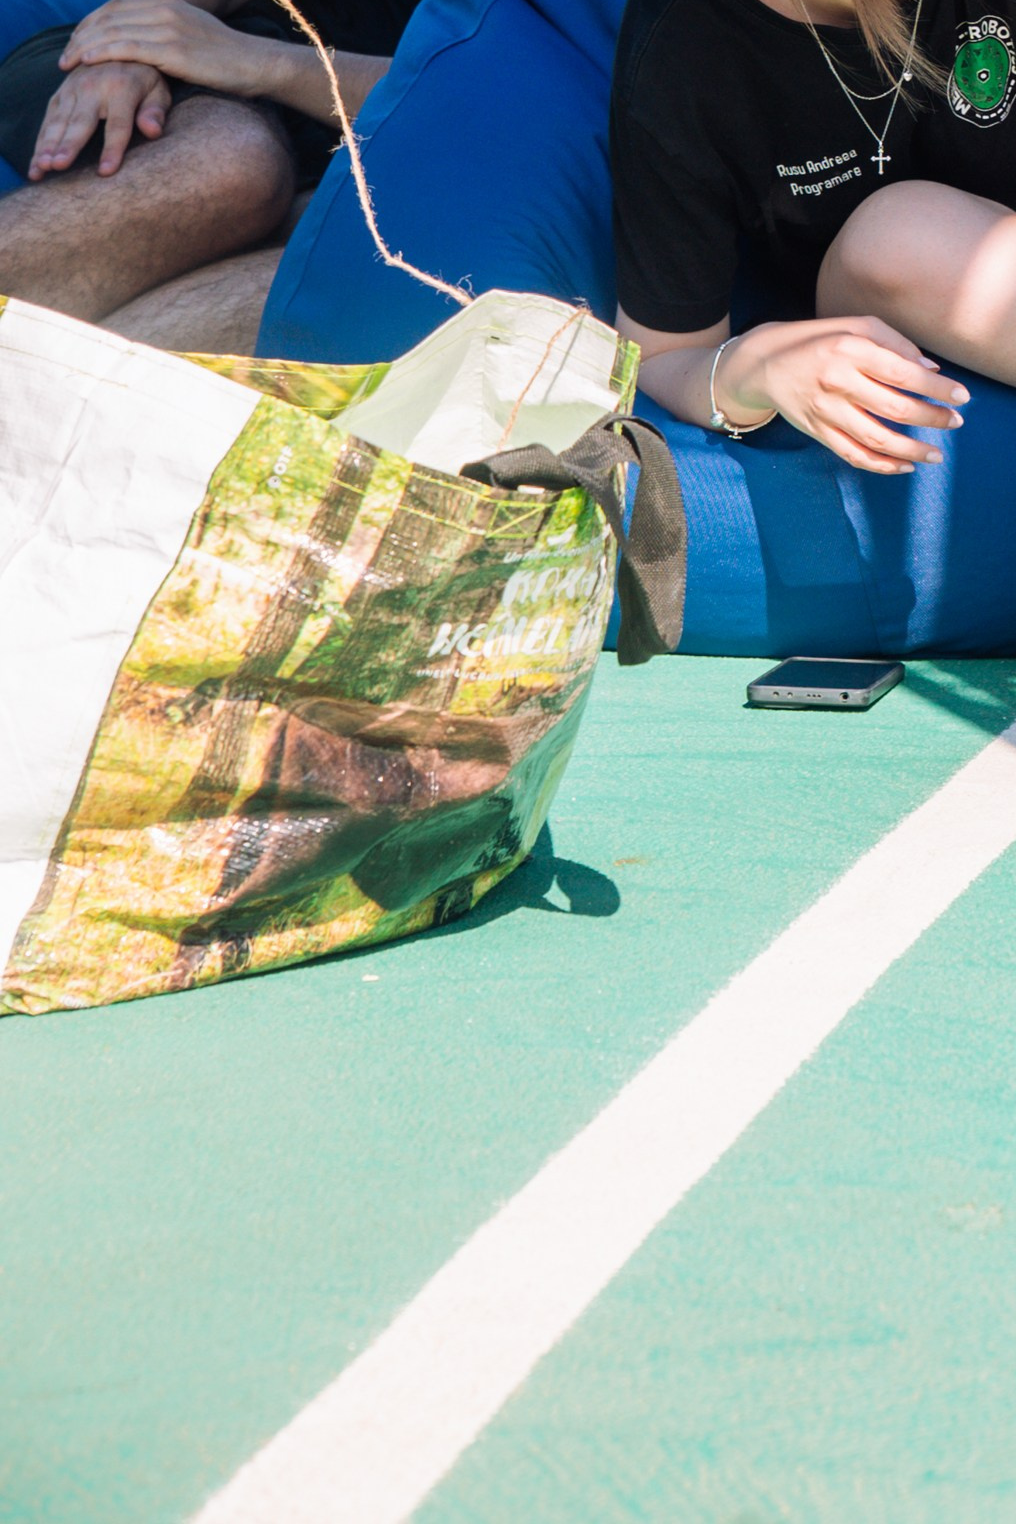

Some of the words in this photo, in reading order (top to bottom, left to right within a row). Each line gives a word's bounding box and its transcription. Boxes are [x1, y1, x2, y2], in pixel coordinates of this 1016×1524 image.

[776, 164, 806, 177] Rusu
[806, 149, 858, 174] Andreea
[790, 166, 862, 196] Programare
